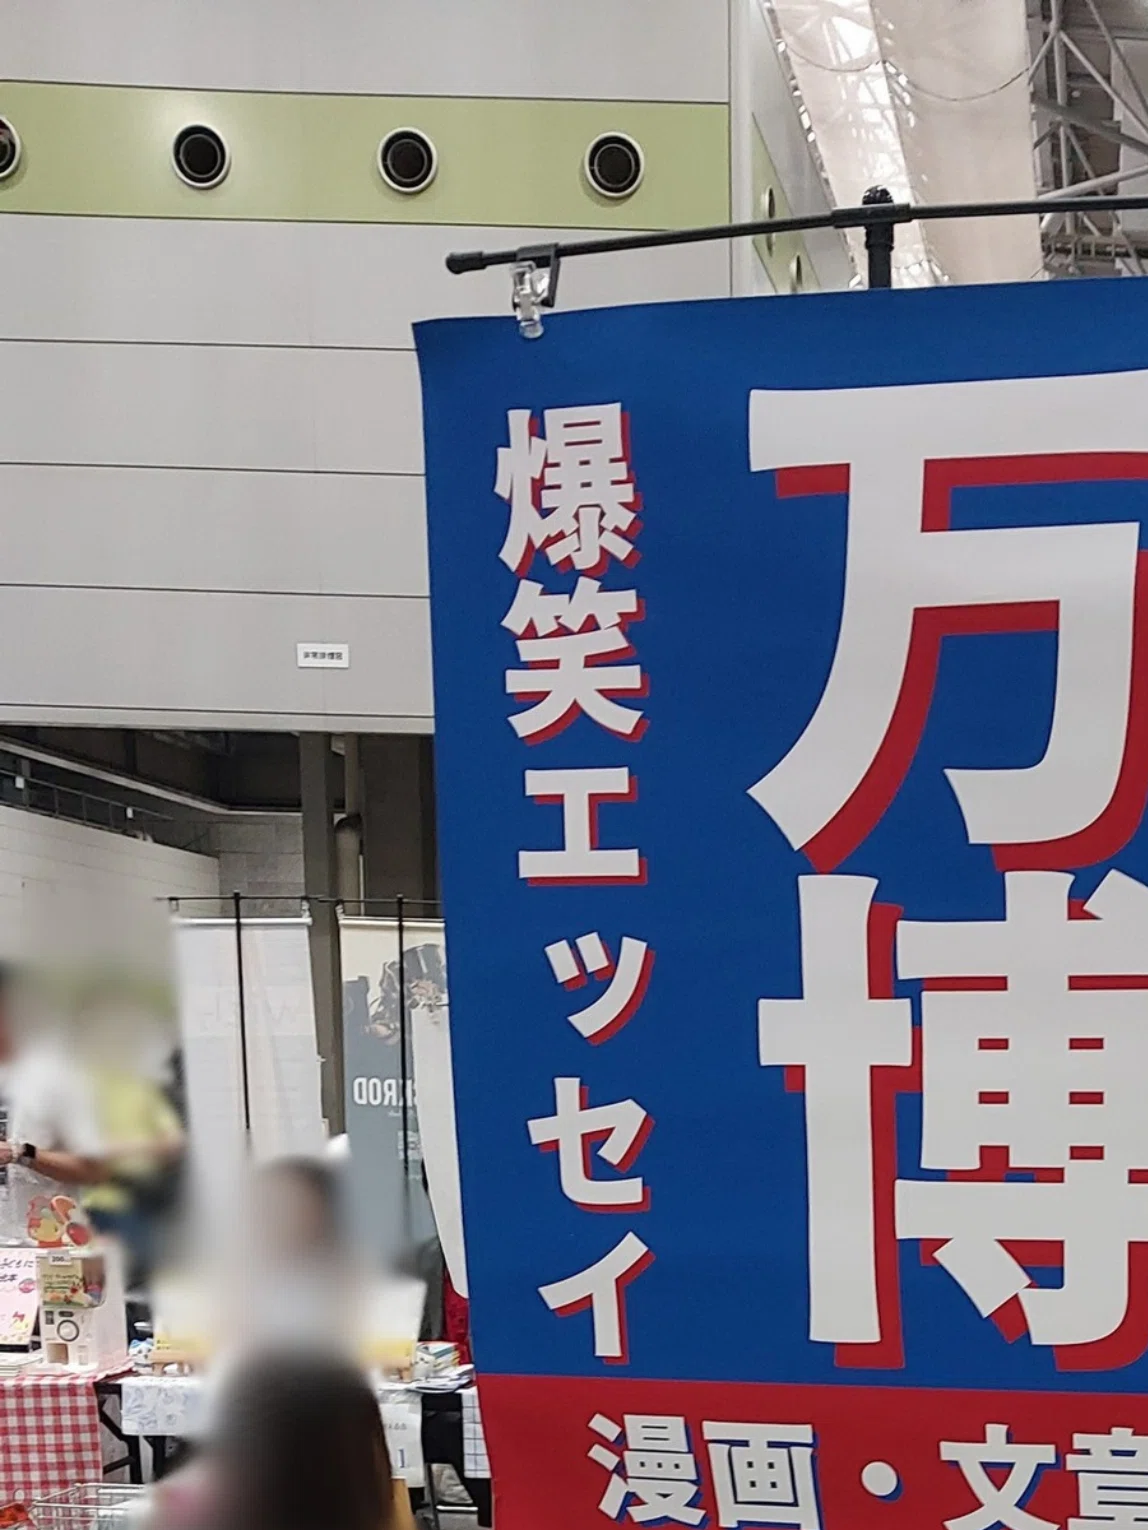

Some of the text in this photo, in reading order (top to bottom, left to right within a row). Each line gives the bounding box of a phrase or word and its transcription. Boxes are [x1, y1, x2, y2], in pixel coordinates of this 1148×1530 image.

[495, 402, 652, 1360] 爆笑エッセイ
